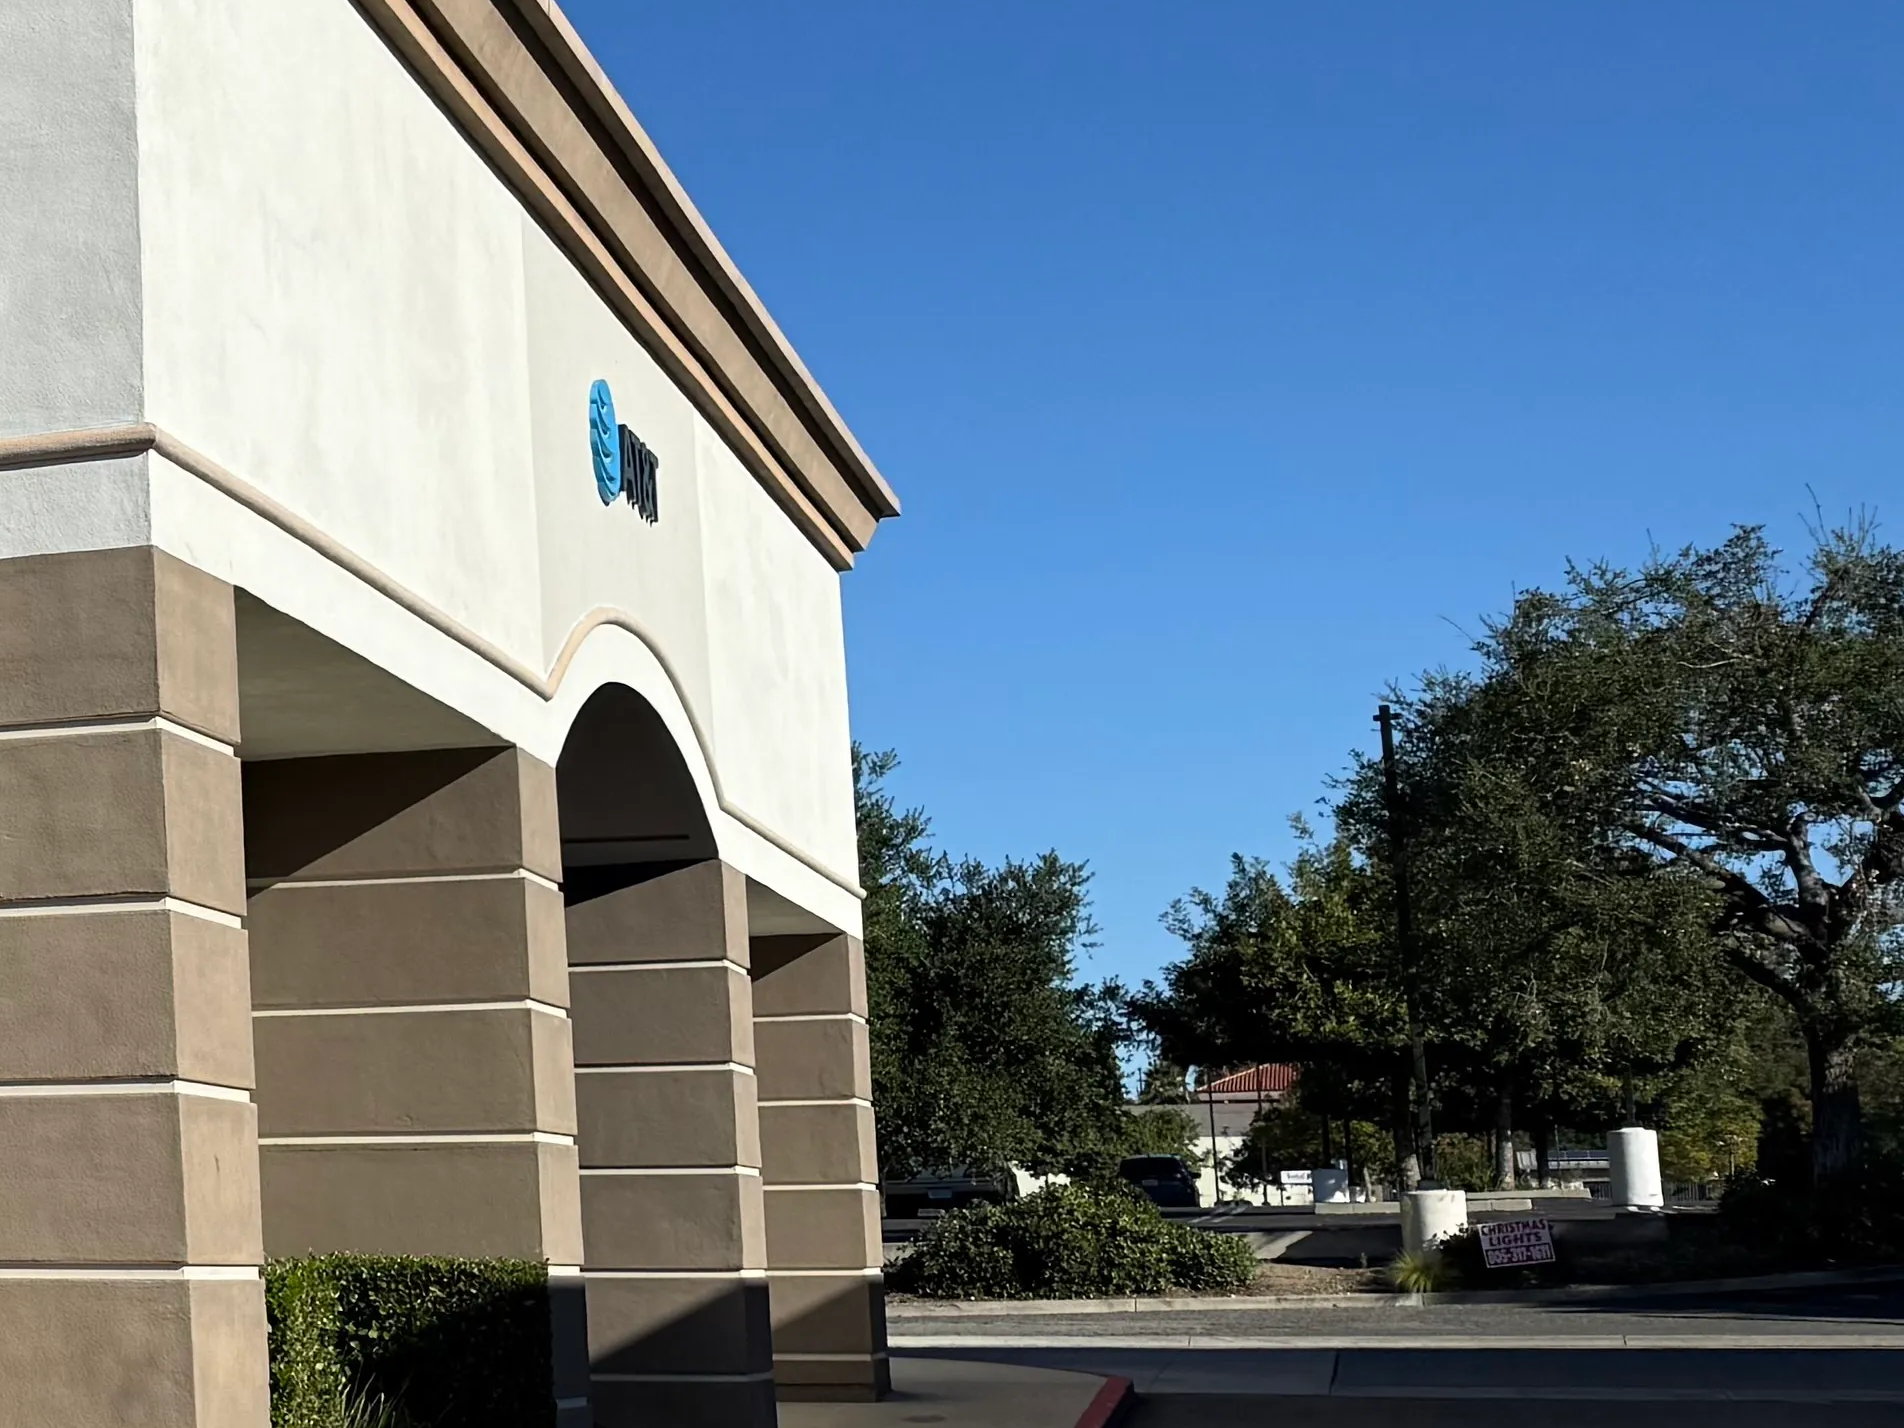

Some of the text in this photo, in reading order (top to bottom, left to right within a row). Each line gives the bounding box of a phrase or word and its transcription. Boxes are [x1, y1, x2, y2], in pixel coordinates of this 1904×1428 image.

[618, 424, 659, 527] AT&T
[1481, 1219, 1547, 1236] CHRISTMAS
[1489, 1231, 1542, 1247] LIGHTS
